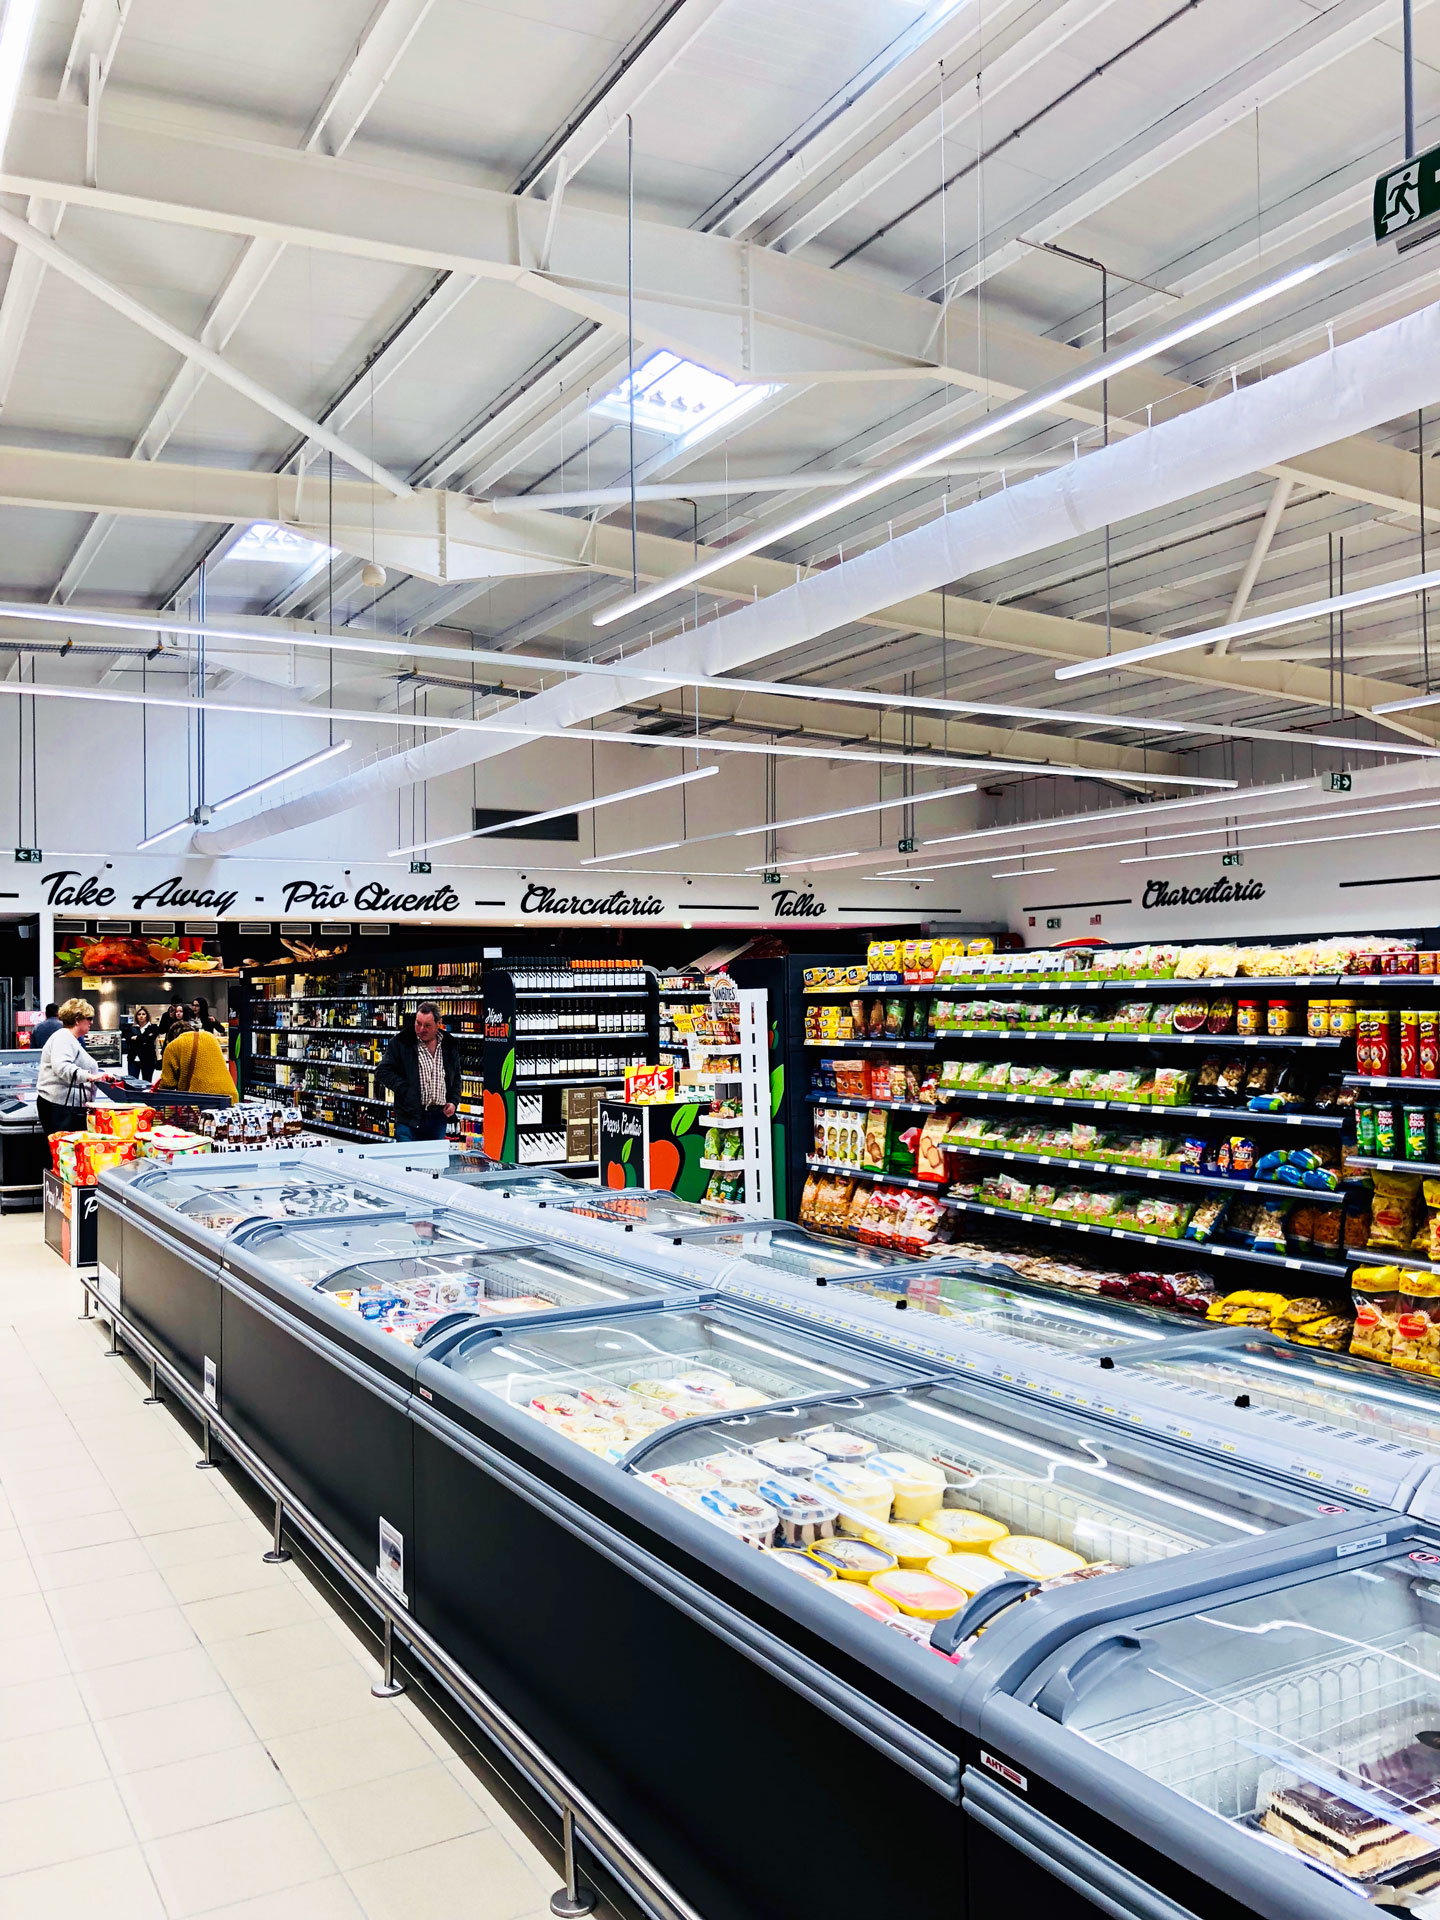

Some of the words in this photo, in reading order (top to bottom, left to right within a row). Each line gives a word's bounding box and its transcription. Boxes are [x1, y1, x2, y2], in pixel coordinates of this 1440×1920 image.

[41, 871, 117, 907] Take
[132, 876, 239, 917] Away
[282, 880, 349, 913] Pão
[354, 881, 460, 912] Quente
[520, 883, 665, 916] Charcutaria
[771, 889, 827, 917] Talho
[1142, 875, 1266, 910] Charcutaria
[985, 1756, 1004, 1772] AHT
